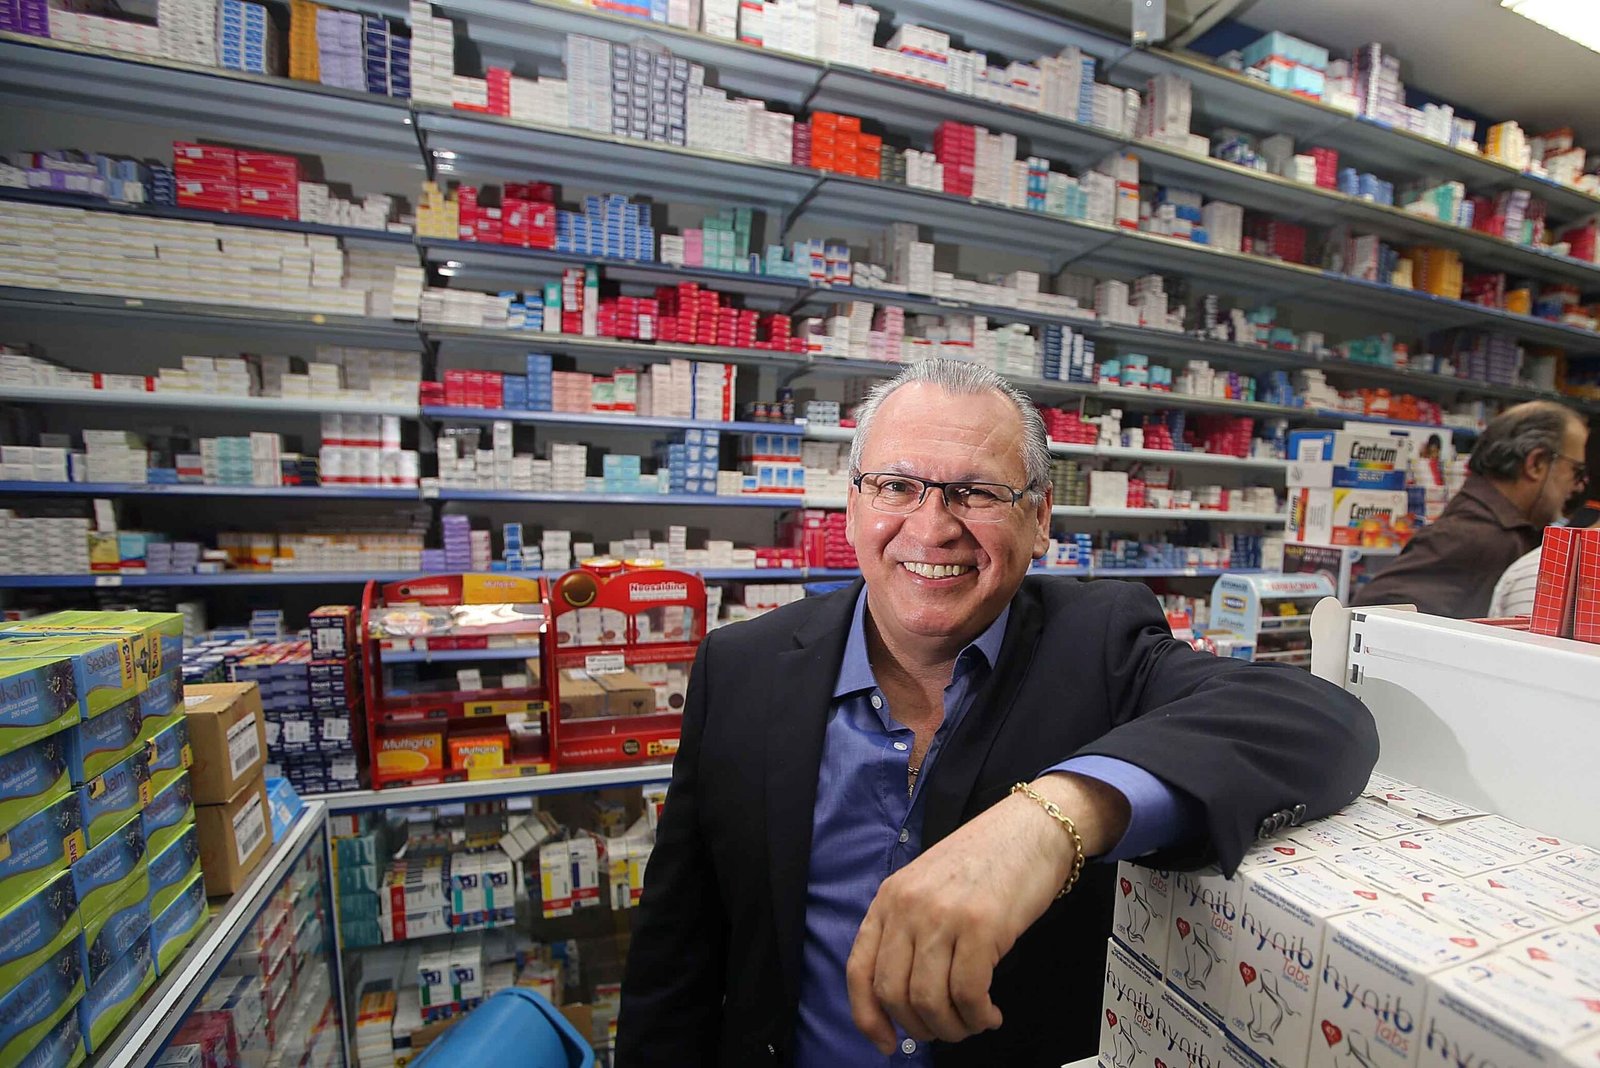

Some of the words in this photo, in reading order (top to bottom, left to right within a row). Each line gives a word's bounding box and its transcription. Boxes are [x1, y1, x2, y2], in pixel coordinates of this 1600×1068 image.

[1350, 440, 1398, 461] Centrum
[1357, 471, 1385, 481] SELECT
[1350, 502, 1393, 520] Centrum
[630, 581, 688, 594] Neosaldina
[383, 738, 436, 750] Multigrip
[1211, 911, 1233, 936] Tabs
[1241, 903, 1314, 969] hynib
[1282, 957, 1311, 986] Tabs
[1106, 962, 1154, 1019] hynib
[1324, 954, 1414, 1033] hynib
[1133, 1006, 1152, 1032] Tabs
[1373, 1014, 1409, 1051] Tabs
